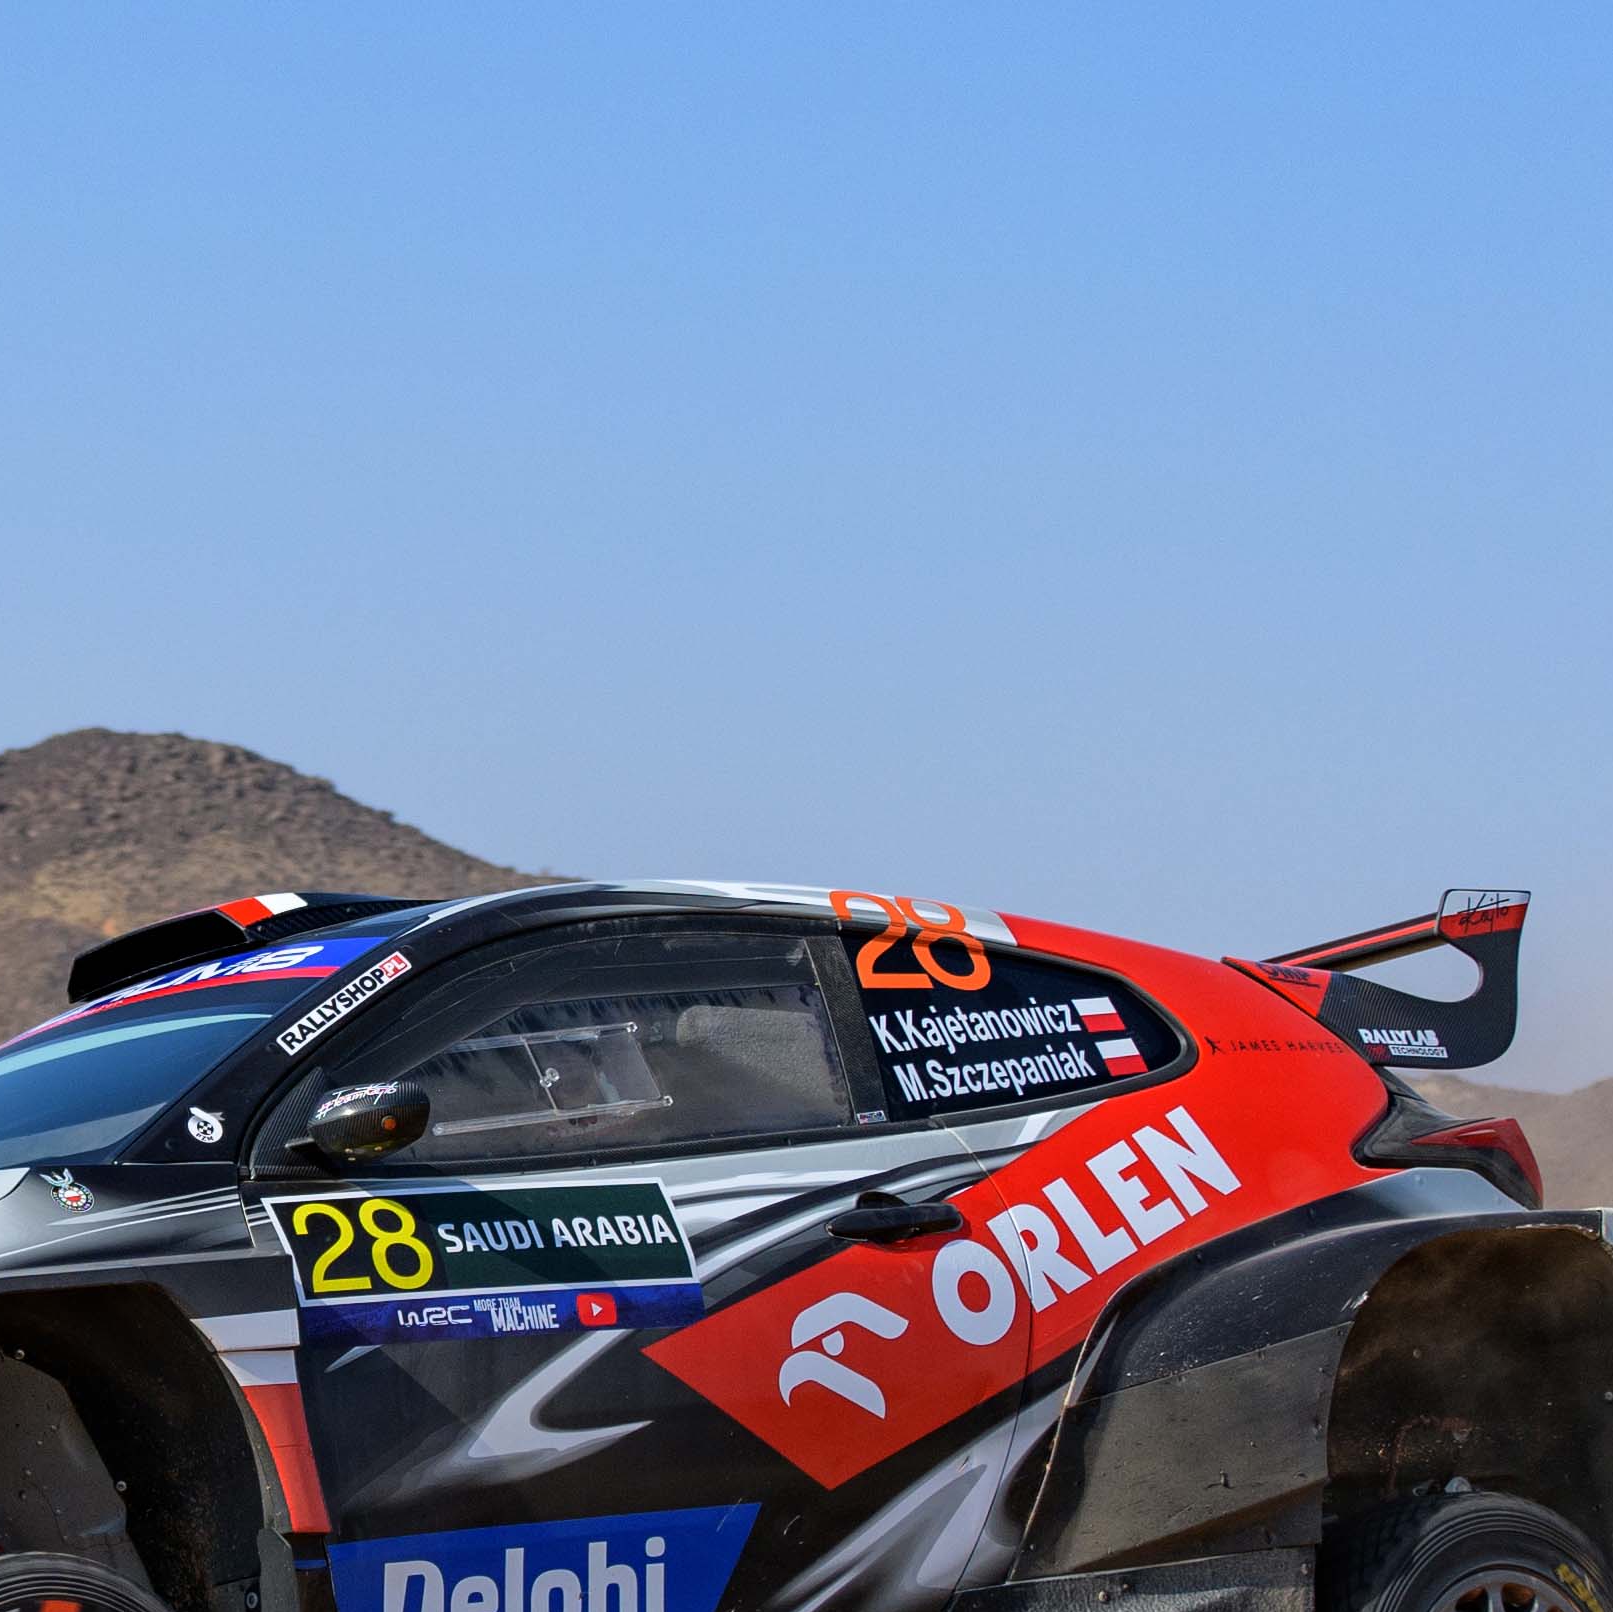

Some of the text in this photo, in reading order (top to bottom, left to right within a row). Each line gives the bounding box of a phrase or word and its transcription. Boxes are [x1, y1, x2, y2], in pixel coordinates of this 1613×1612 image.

[829, 889, 992, 991] 28
[869, 997, 1082, 1054] K.Kajetanowicz
[1390, 1045, 1447, 1057] TECHNOLOGY
[893, 1042, 1097, 1102] M.Szczepaniak
[292, 1198, 679, 1293] 28 SAUDI ARABIA
[932, 1105, 1243, 1346] ORLEN
[397, 1304, 473, 1327] WRC
[473, 1298, 498, 1312] MORE
[490, 1304, 560, 1332] MACHINE
